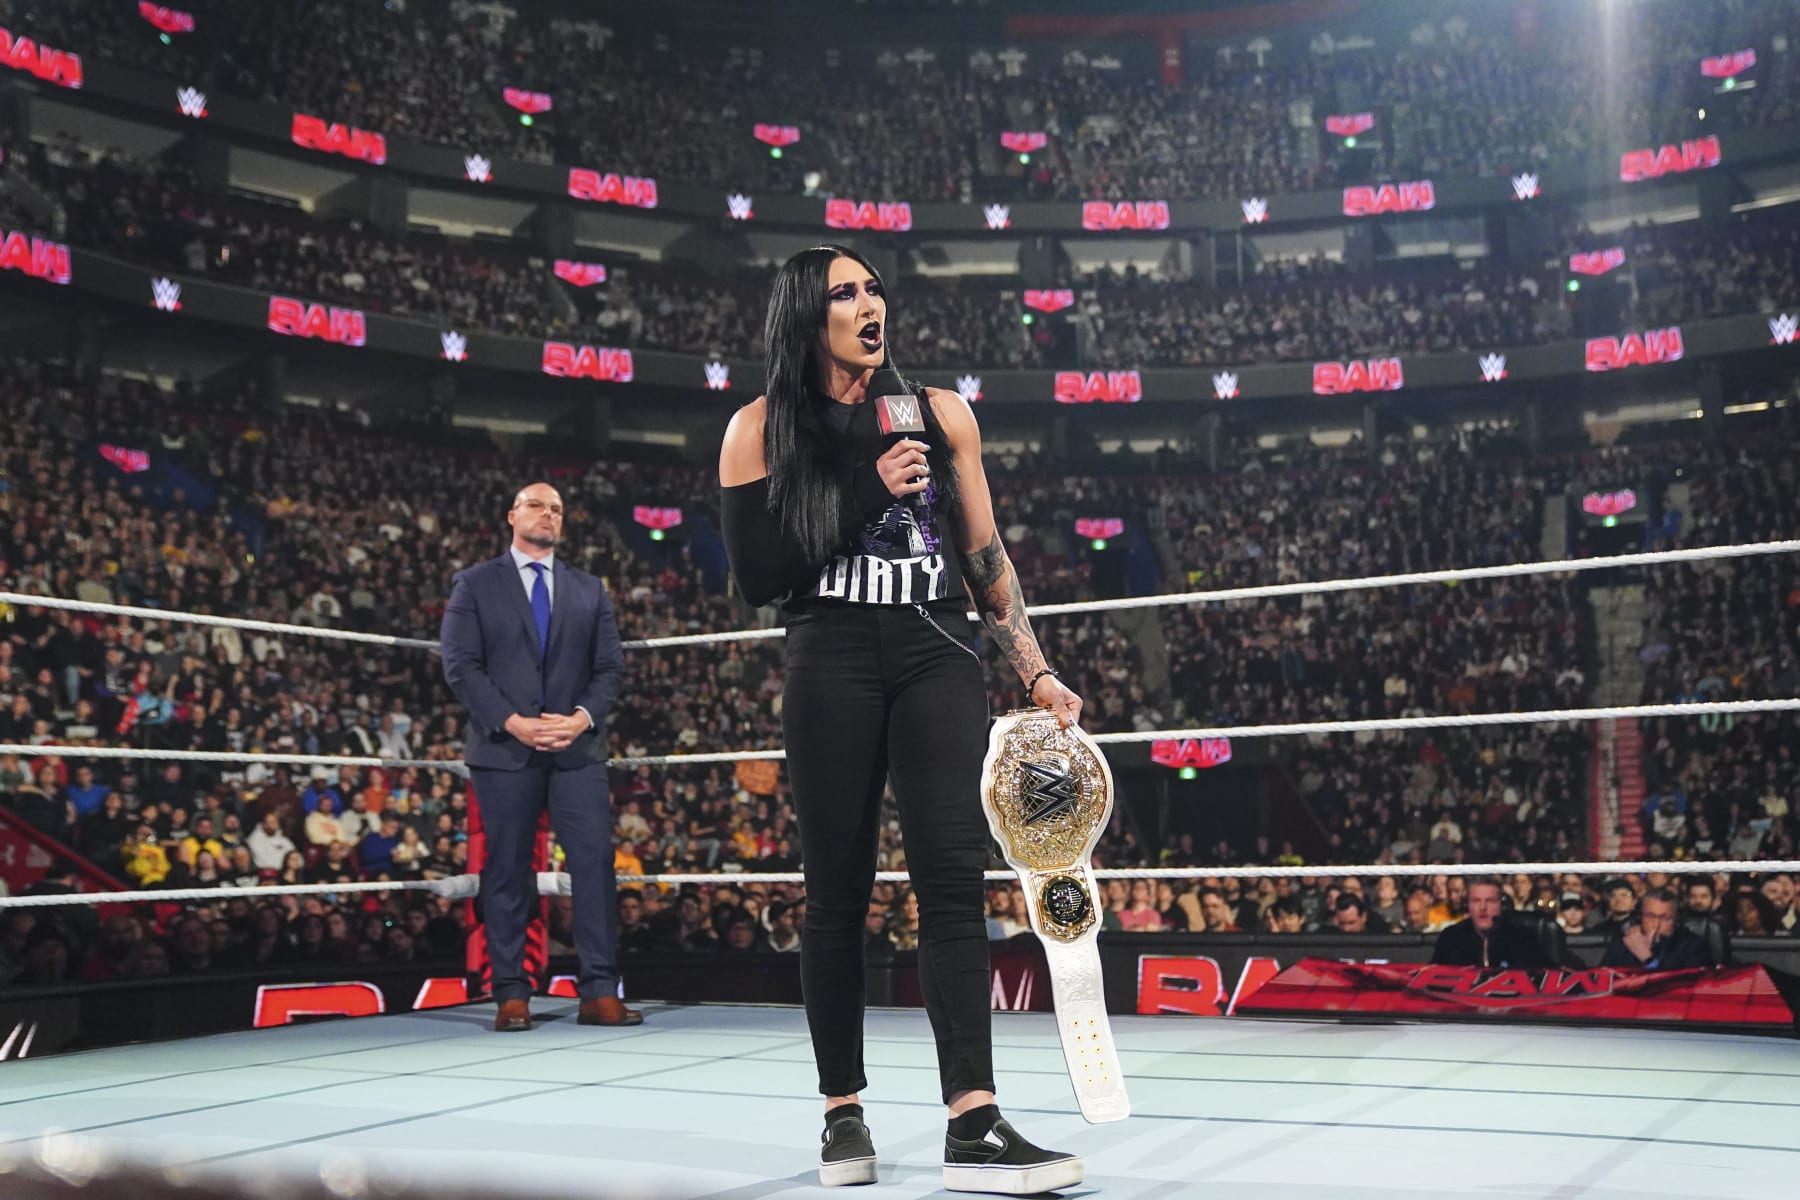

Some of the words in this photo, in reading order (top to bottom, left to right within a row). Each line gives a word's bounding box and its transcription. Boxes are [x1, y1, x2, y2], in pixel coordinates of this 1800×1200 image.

[291, 113, 386, 165] RAW
[1620, 136, 1721, 181] RAW
[568, 168, 658, 208] RAW
[1343, 180, 1434, 217] RAW
[825, 200, 912, 231] RAW
[1082, 201, 1170, 231] RAW
[268, 296, 366, 346] RAW
[542, 342, 634, 381] RAW
[1585, 327, 1683, 372] RAW
[1055, 371, 1142, 402] RAW
[1312, 358, 1403, 395] RAW
[1151, 737, 1232, 768] RAW
[1407, 964, 1614, 1006] RAW
